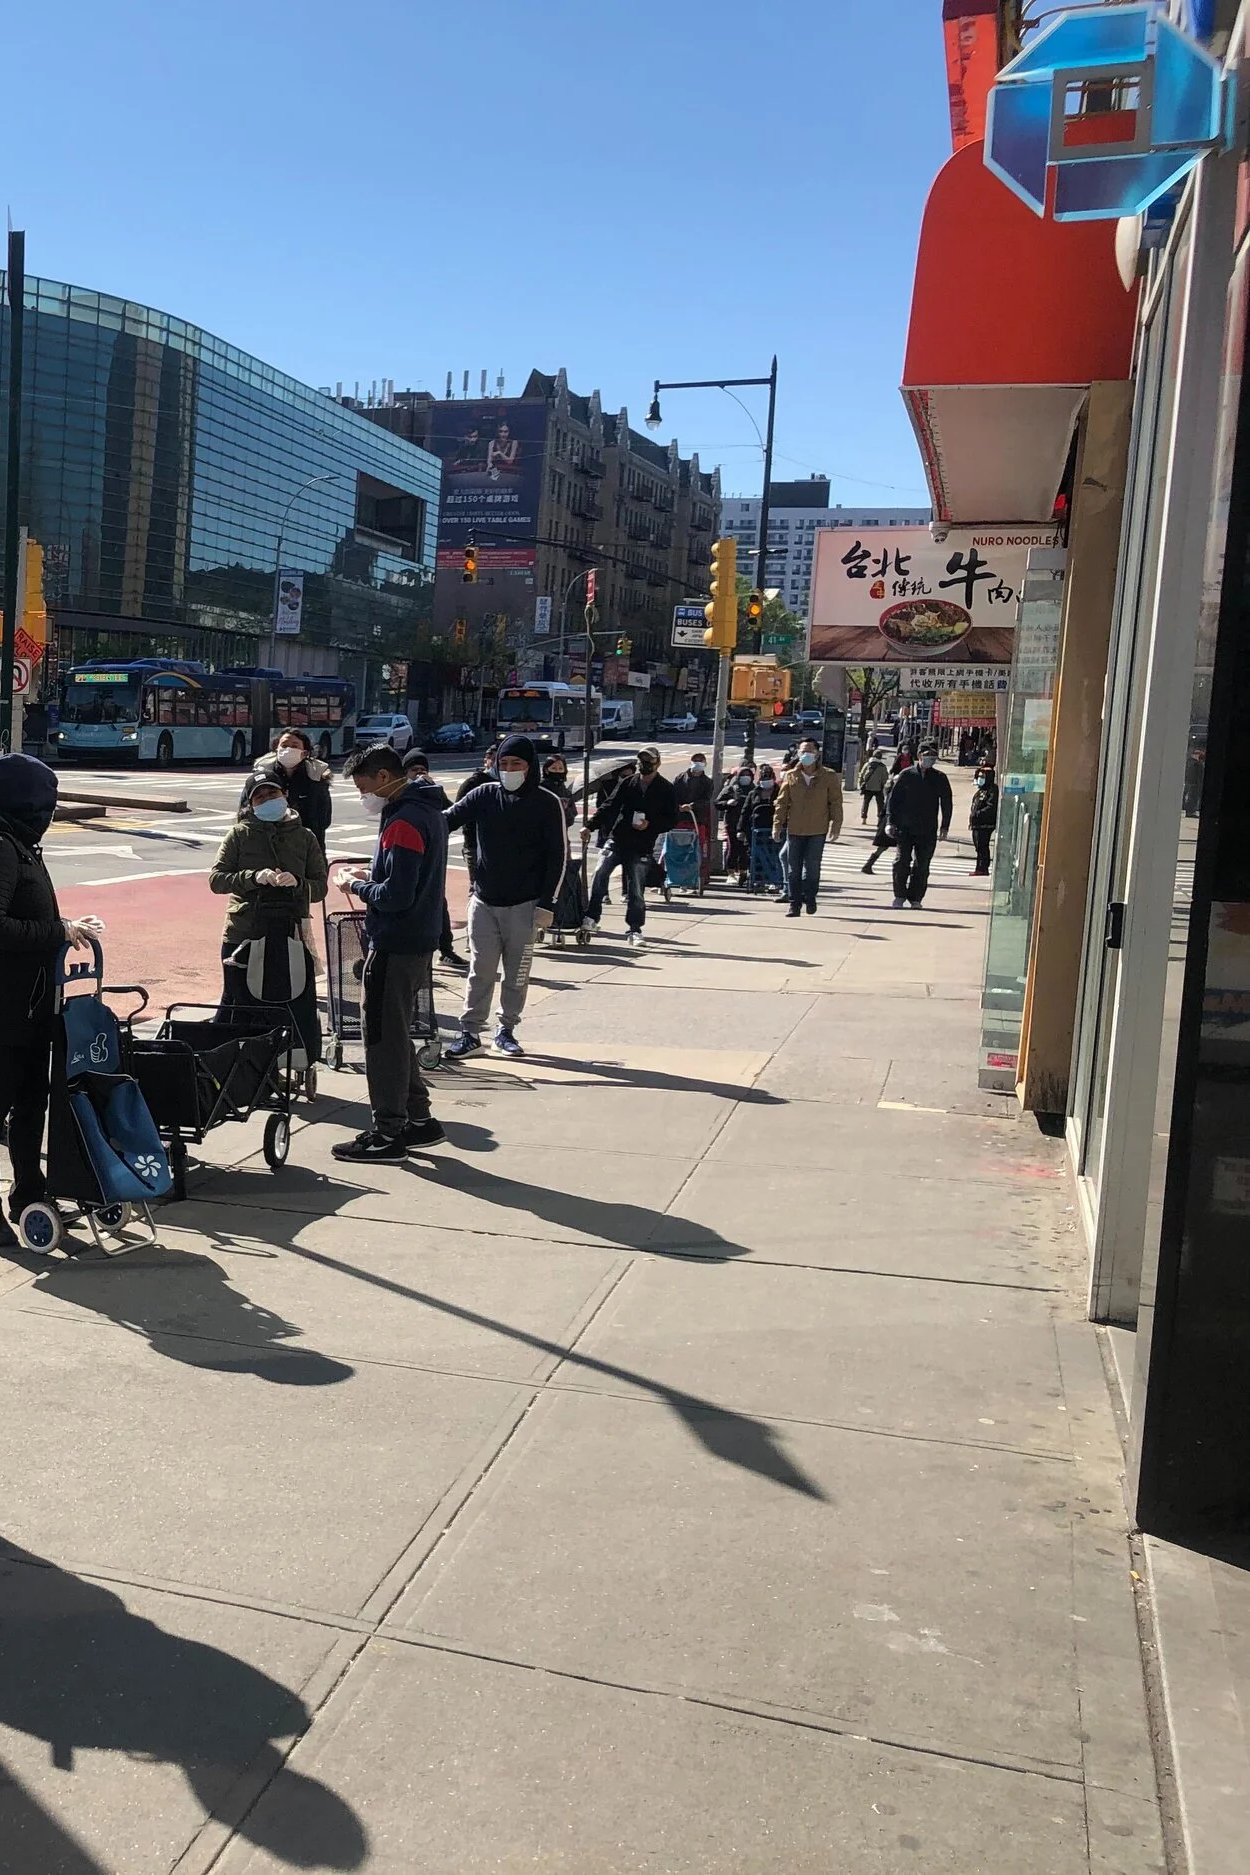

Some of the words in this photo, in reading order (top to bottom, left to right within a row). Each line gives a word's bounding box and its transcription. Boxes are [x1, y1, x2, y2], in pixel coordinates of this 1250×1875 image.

[972, 536, 1004, 546] NURO
[1006, 536, 1060, 546] NOODLES
[841, 540, 912, 579] 台北
[687, 608, 703, 617] BUS
[677, 618, 703, 627] BUSES
[16, 631, 41, 658] RAISE
